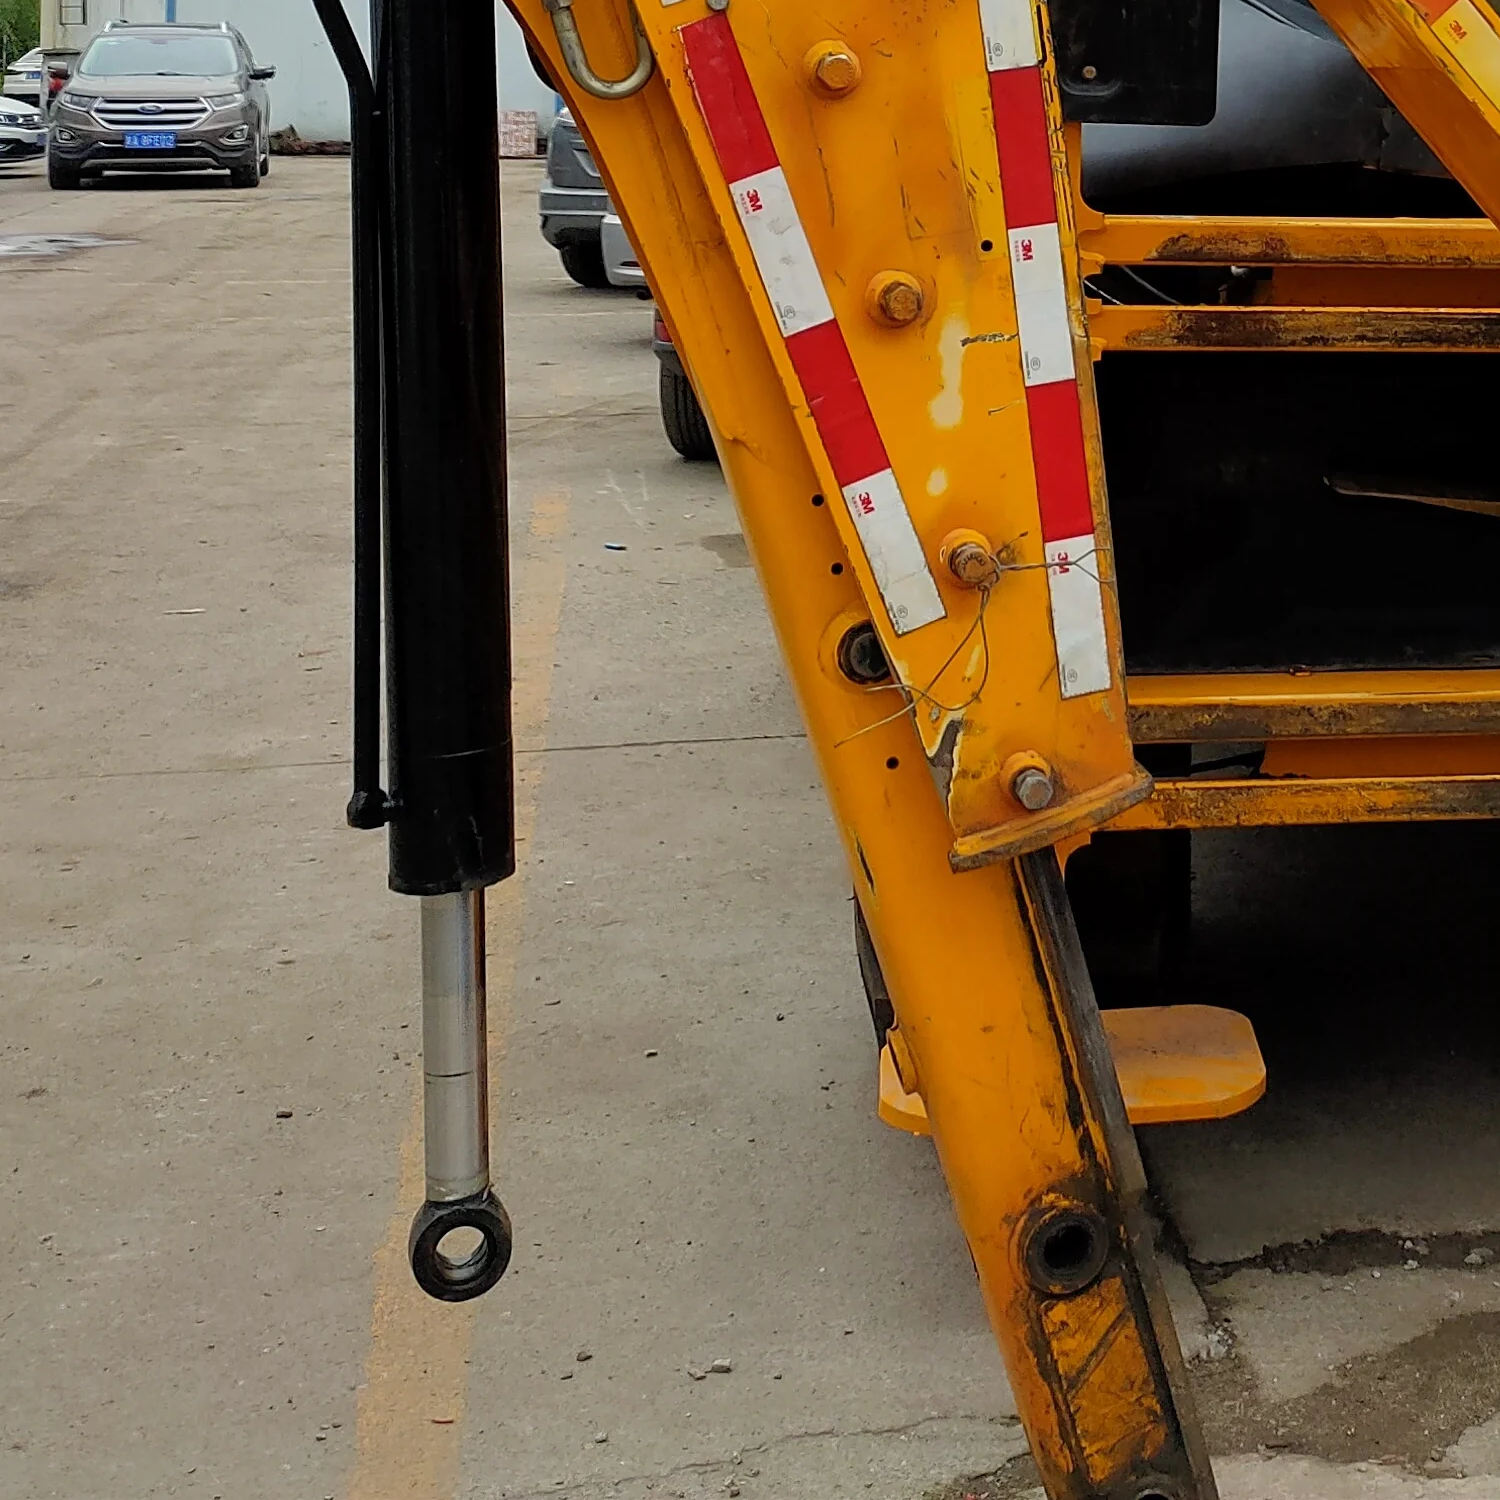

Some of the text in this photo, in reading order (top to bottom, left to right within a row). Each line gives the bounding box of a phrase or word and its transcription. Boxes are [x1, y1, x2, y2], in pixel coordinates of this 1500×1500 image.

[1449, 20, 1468, 39] 3M
[746, 188, 763, 212] 3M
[1021, 239, 1033, 261] 3M
[859, 491, 875, 514] 3M
